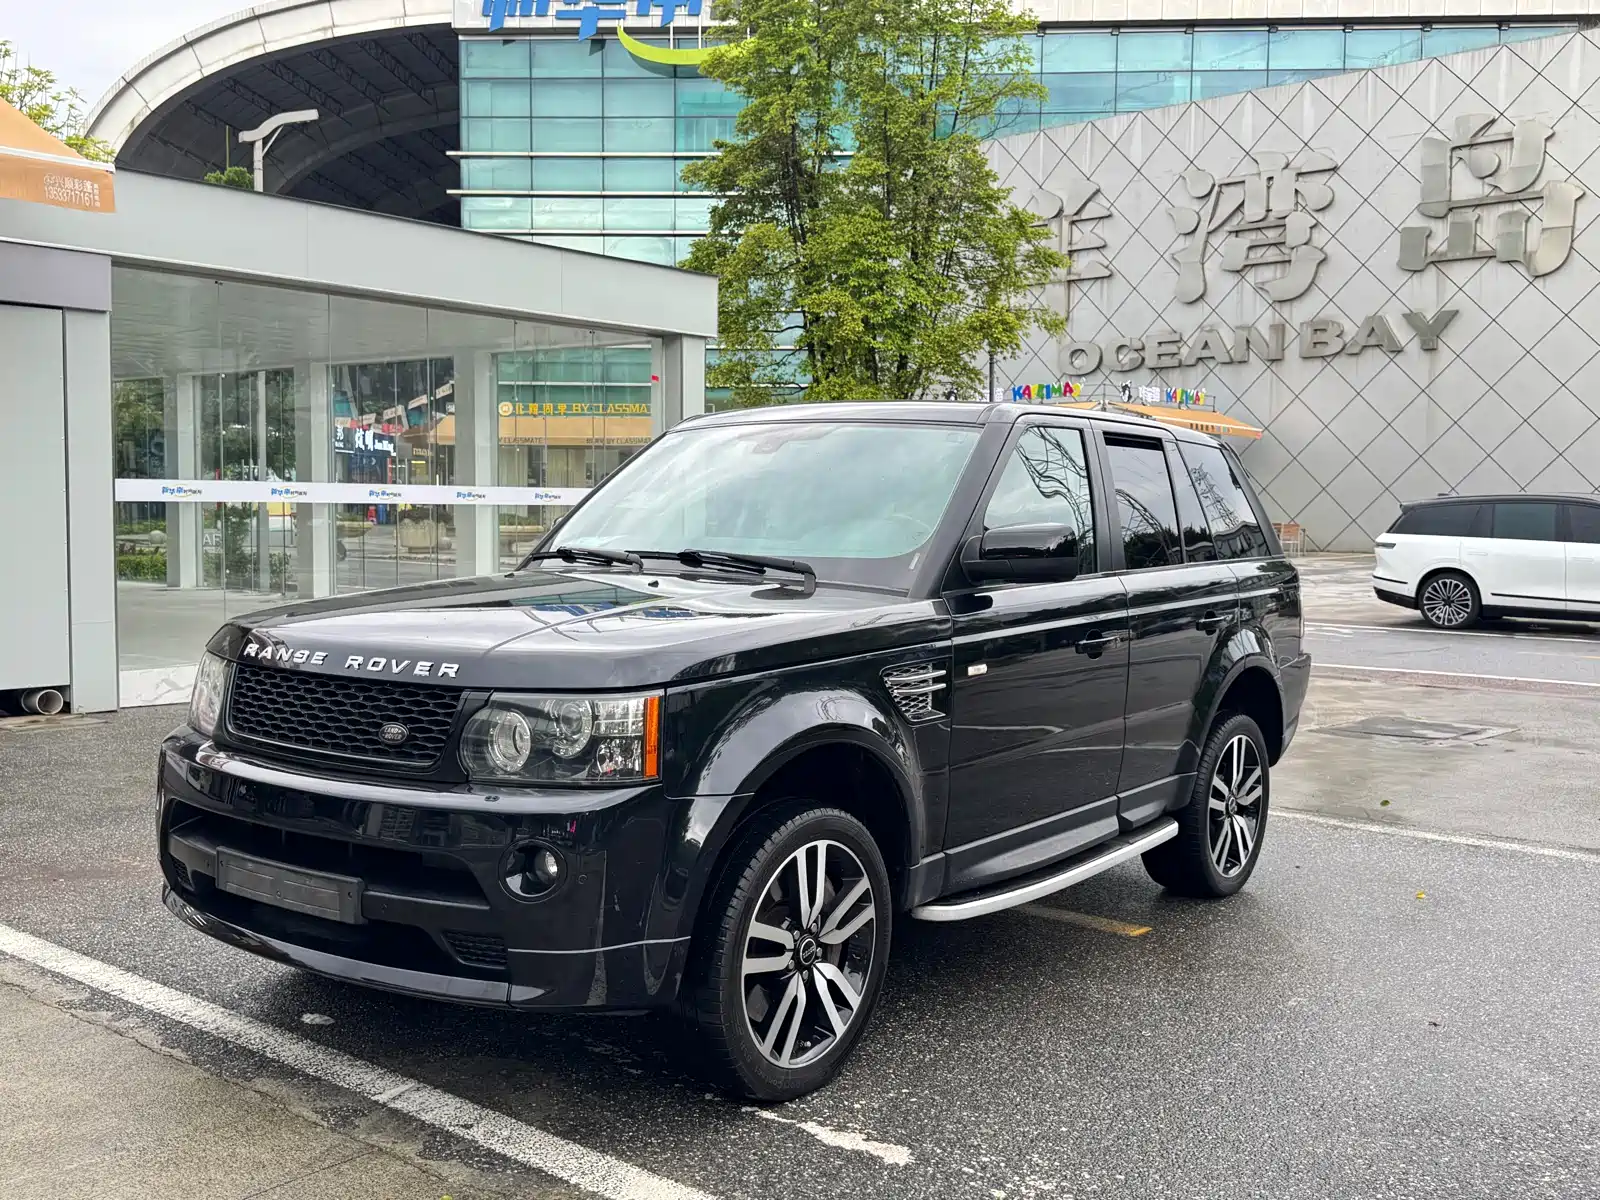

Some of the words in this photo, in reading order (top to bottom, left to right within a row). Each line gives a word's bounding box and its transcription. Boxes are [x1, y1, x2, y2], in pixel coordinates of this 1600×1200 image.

[1059, 322, 1286, 377] OCEAN
[1299, 307, 1460, 360] BAY
[572, 403, 590, 414] BY
[243, 643, 328, 665] RANGE
[344, 655, 460, 678] ROVER
